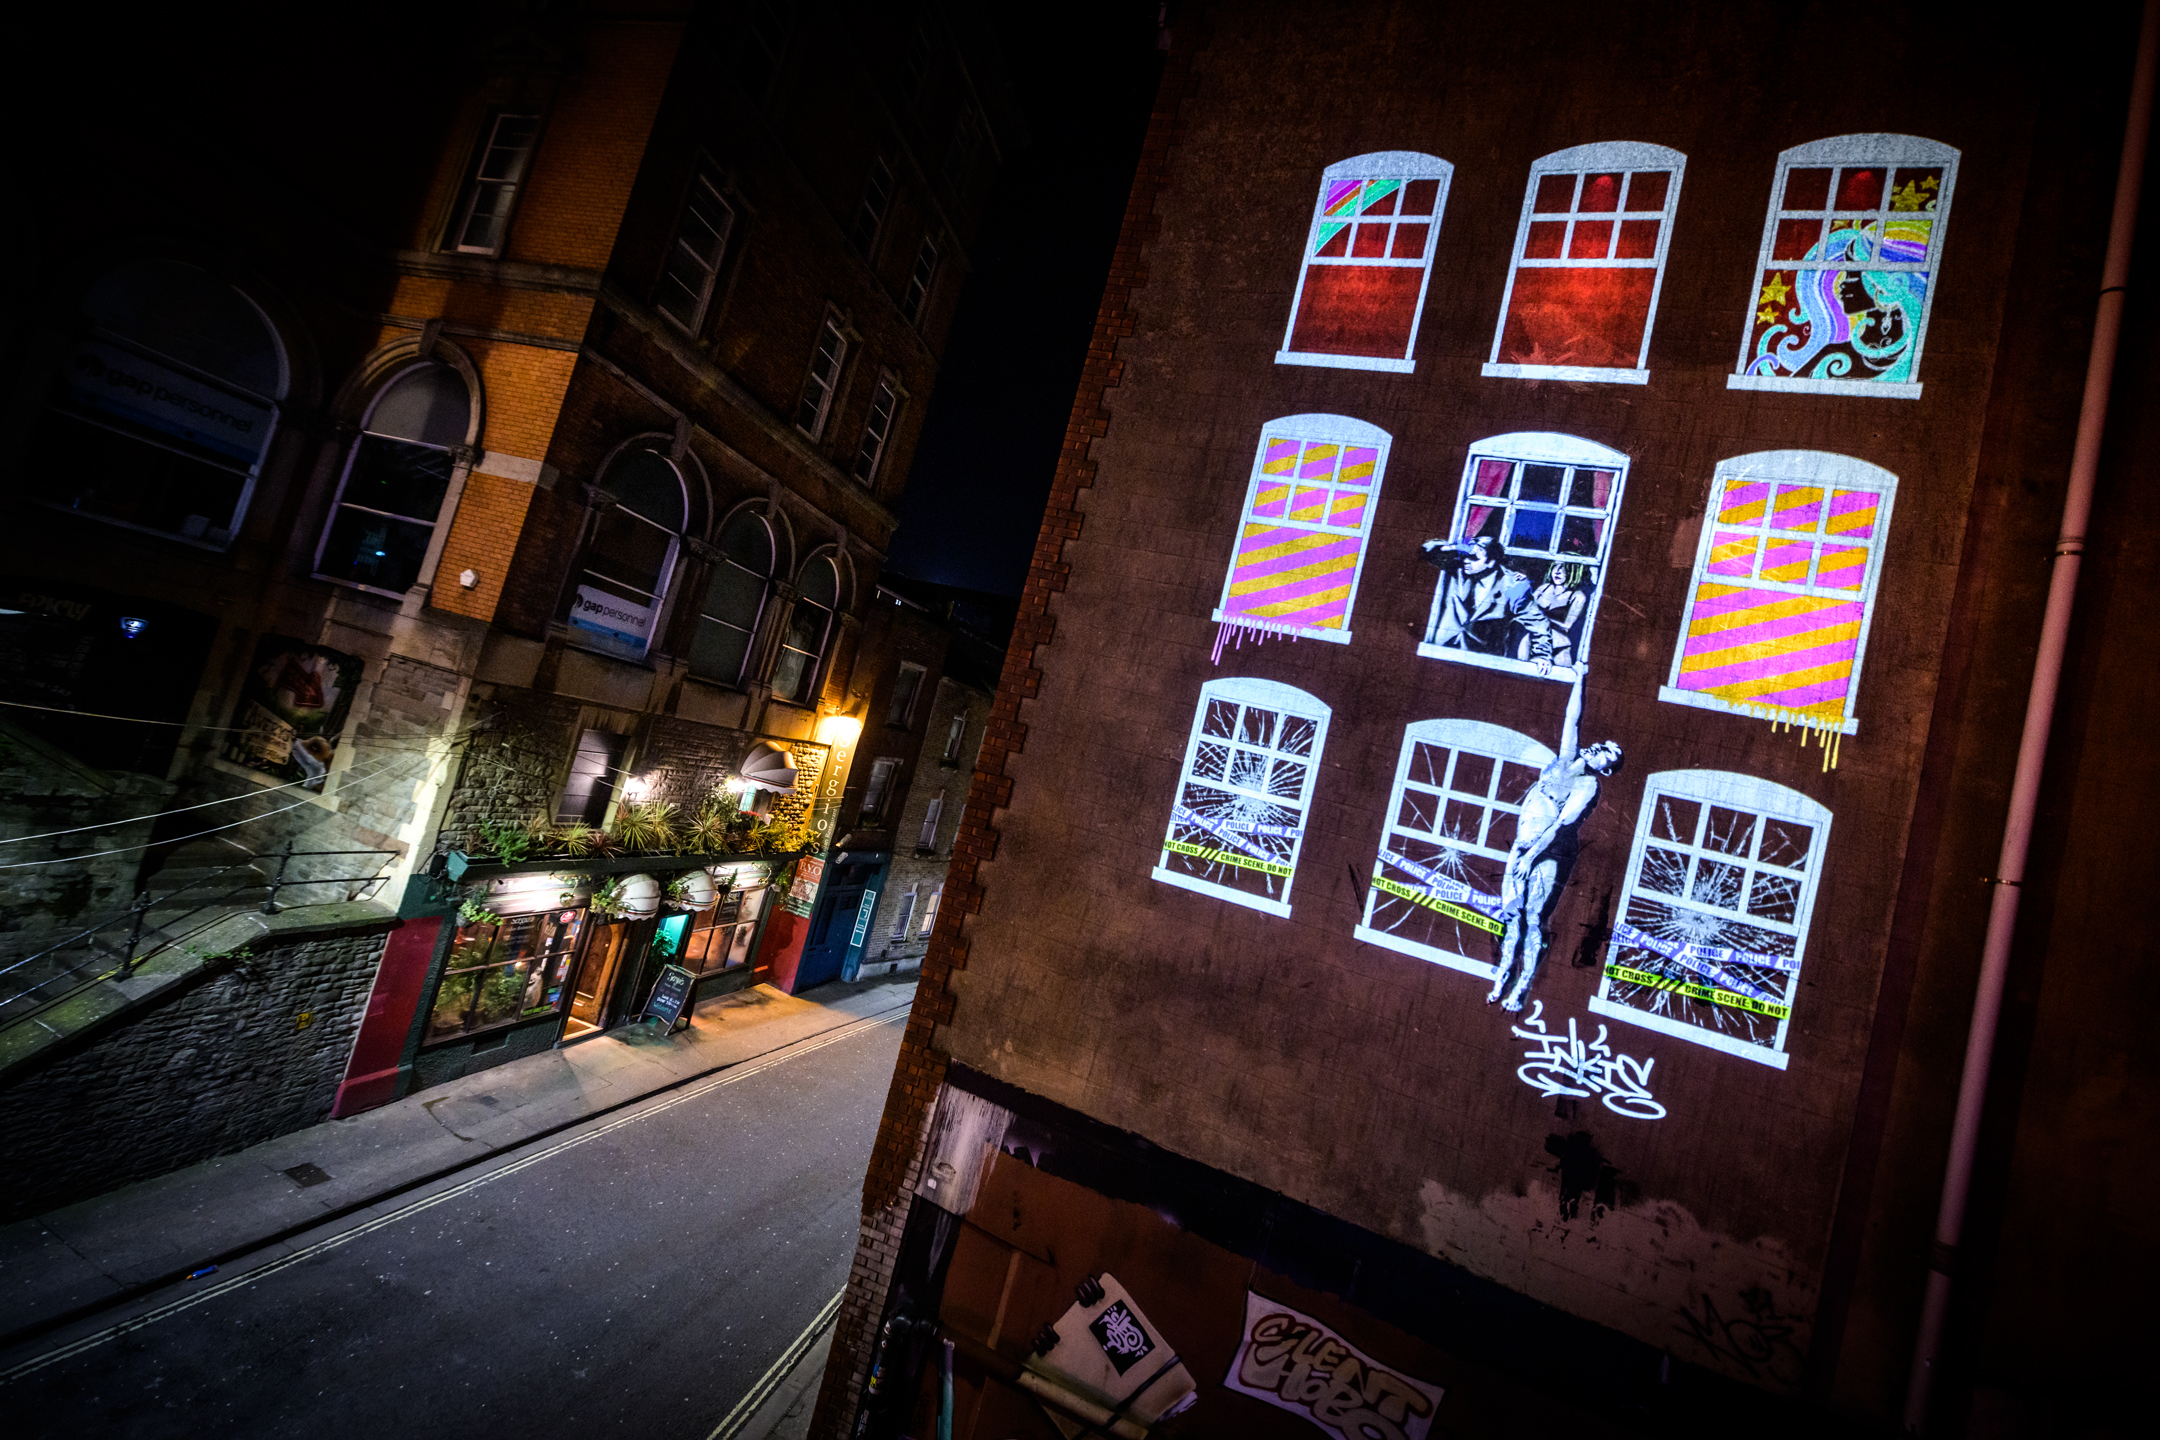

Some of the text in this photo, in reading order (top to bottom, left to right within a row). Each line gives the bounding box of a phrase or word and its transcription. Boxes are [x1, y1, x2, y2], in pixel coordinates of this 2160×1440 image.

[106, 369, 253, 433] gap personnel
[583, 600, 646, 627] gap personnel
[1191, 813, 1215, 831] POLICE
[1218, 828, 1241, 845] POLICE
[1245, 842, 1270, 861] POLICE
[1225, 821, 1250, 831] POLICE
[1257, 824, 1283, 836] POLICE
[1176, 843, 1199, 855] CROSS
[1220, 853, 1242, 865] CRIME
[1266, 863, 1277, 872] DO
[1278, 866, 1293, 876] NOT
[1399, 860, 1427, 880] POLICE
[1386, 881, 1411, 898] CROSS
[1435, 900, 1460, 917] CRIME
[1487, 921, 1500, 932] DO
[1435, 889, 1463, 901] POLICE
[1472, 893, 1501, 906] POLICE
[1640, 935, 1674, 957] POLICE
[1680, 953, 1714, 976] POLICE
[1720, 973, 1754, 997] POLICE
[1690, 945, 1724, 959] POLICE
[1735, 951, 1772, 966] POLICE
[1621, 969, 1654, 985] CROSS
[1685, 984, 1714, 999] CRIME
[1751, 1001, 1766, 1012] DO
[1767, 1004, 1789, 1018] NOT
